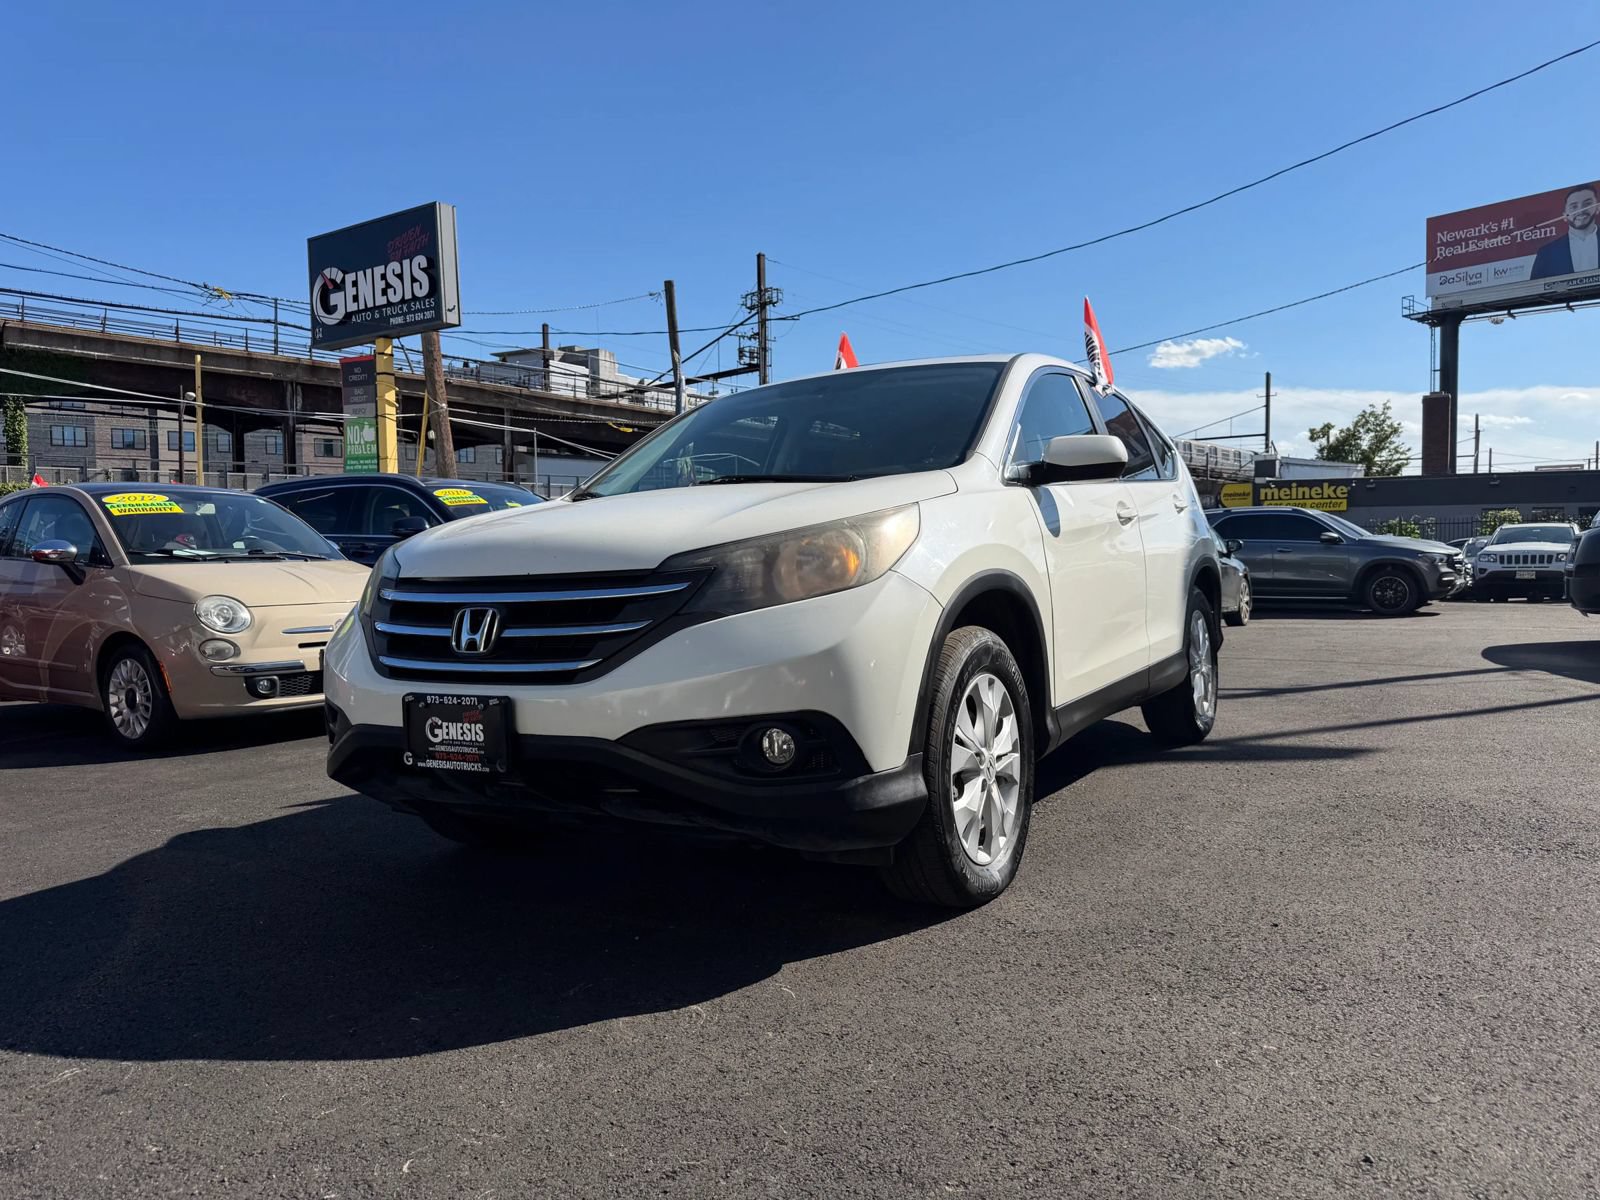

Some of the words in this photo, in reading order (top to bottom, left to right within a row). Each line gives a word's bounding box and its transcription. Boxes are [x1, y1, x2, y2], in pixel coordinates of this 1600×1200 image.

[1436, 222, 1498, 244] Newark's
[1500, 217, 1515, 231] #1
[1436, 241, 1465, 260] Real
[1468, 234, 1511, 251] Estate
[1513, 226, 1557, 242] Team
[1439, 270, 1482, 286] DaSilva
[1493, 266, 1508, 276] kw
[313, 254, 430, 326] GENESIS
[351, 310, 372, 324] AUTO
[374, 310, 380, 319] &
[382, 304, 408, 317] TRUCK
[411, 297, 435, 311] SALES
[406, 313, 414, 323] 973
[424, 310, 435, 321] 2071
[347, 425, 360, 445] NO
[116, 495, 156, 503] 2012
[1260, 482, 1348, 500] meineke
[116, 506, 174, 514] WARRANTY
[1310, 501, 1343, 509] center
[426, 695, 478, 706] 973-624-2071
[425, 716, 485, 743] GENESIS
[403, 751, 413, 766] G
